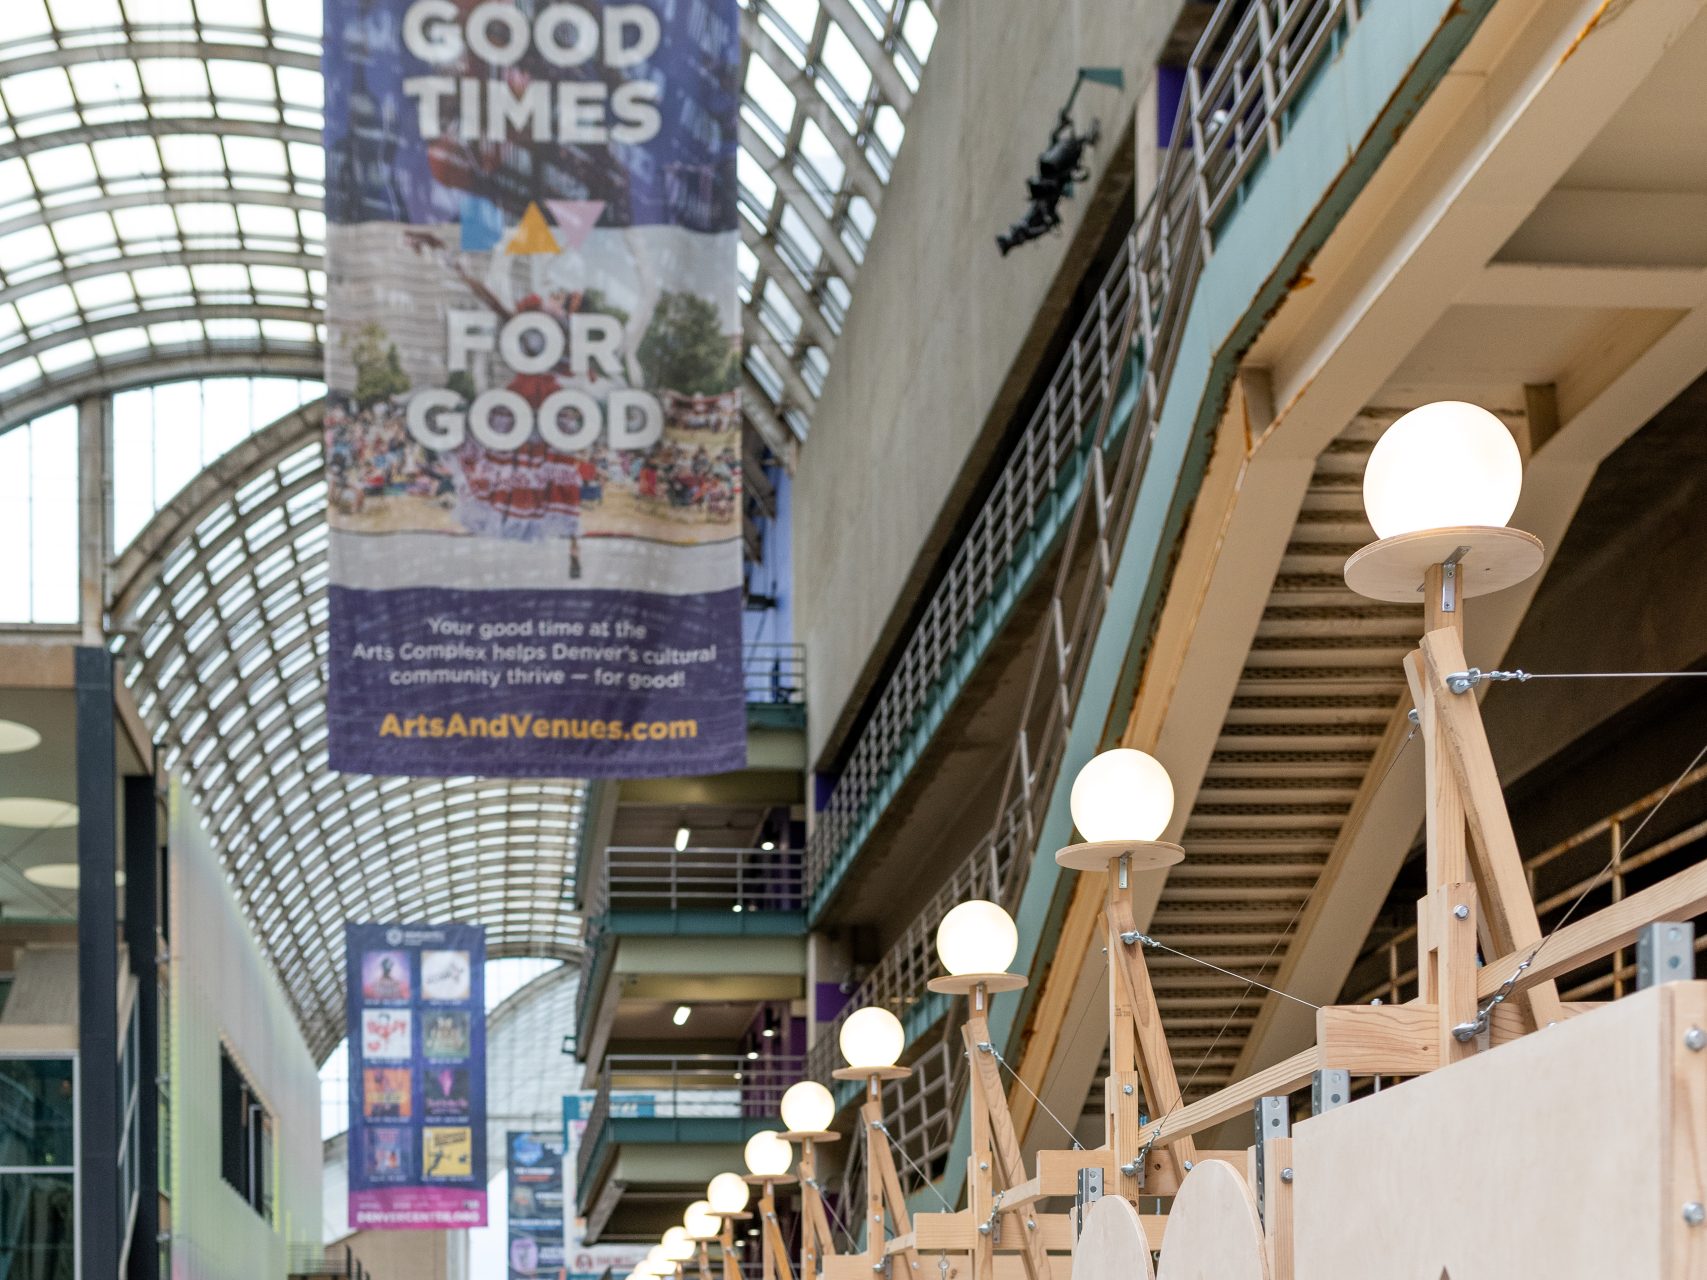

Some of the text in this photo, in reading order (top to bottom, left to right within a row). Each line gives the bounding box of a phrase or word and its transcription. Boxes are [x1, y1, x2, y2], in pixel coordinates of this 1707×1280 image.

[402, 0, 662, 68] GOOD
[403, 77, 662, 144] TIMES
[447, 309, 626, 376] FOR
[406, 387, 665, 452] GOOD
[352, 642, 717, 664] Arts Complex helps Denver's cultural
[428, 618, 647, 642] Your good time at the
[389, 666, 501, 688] community
[507, 667, 566, 686] thrive
[593, 668, 624, 686] for
[628, 669, 686, 690] good!
[379, 713, 699, 742] ArtsAndVenues.com
